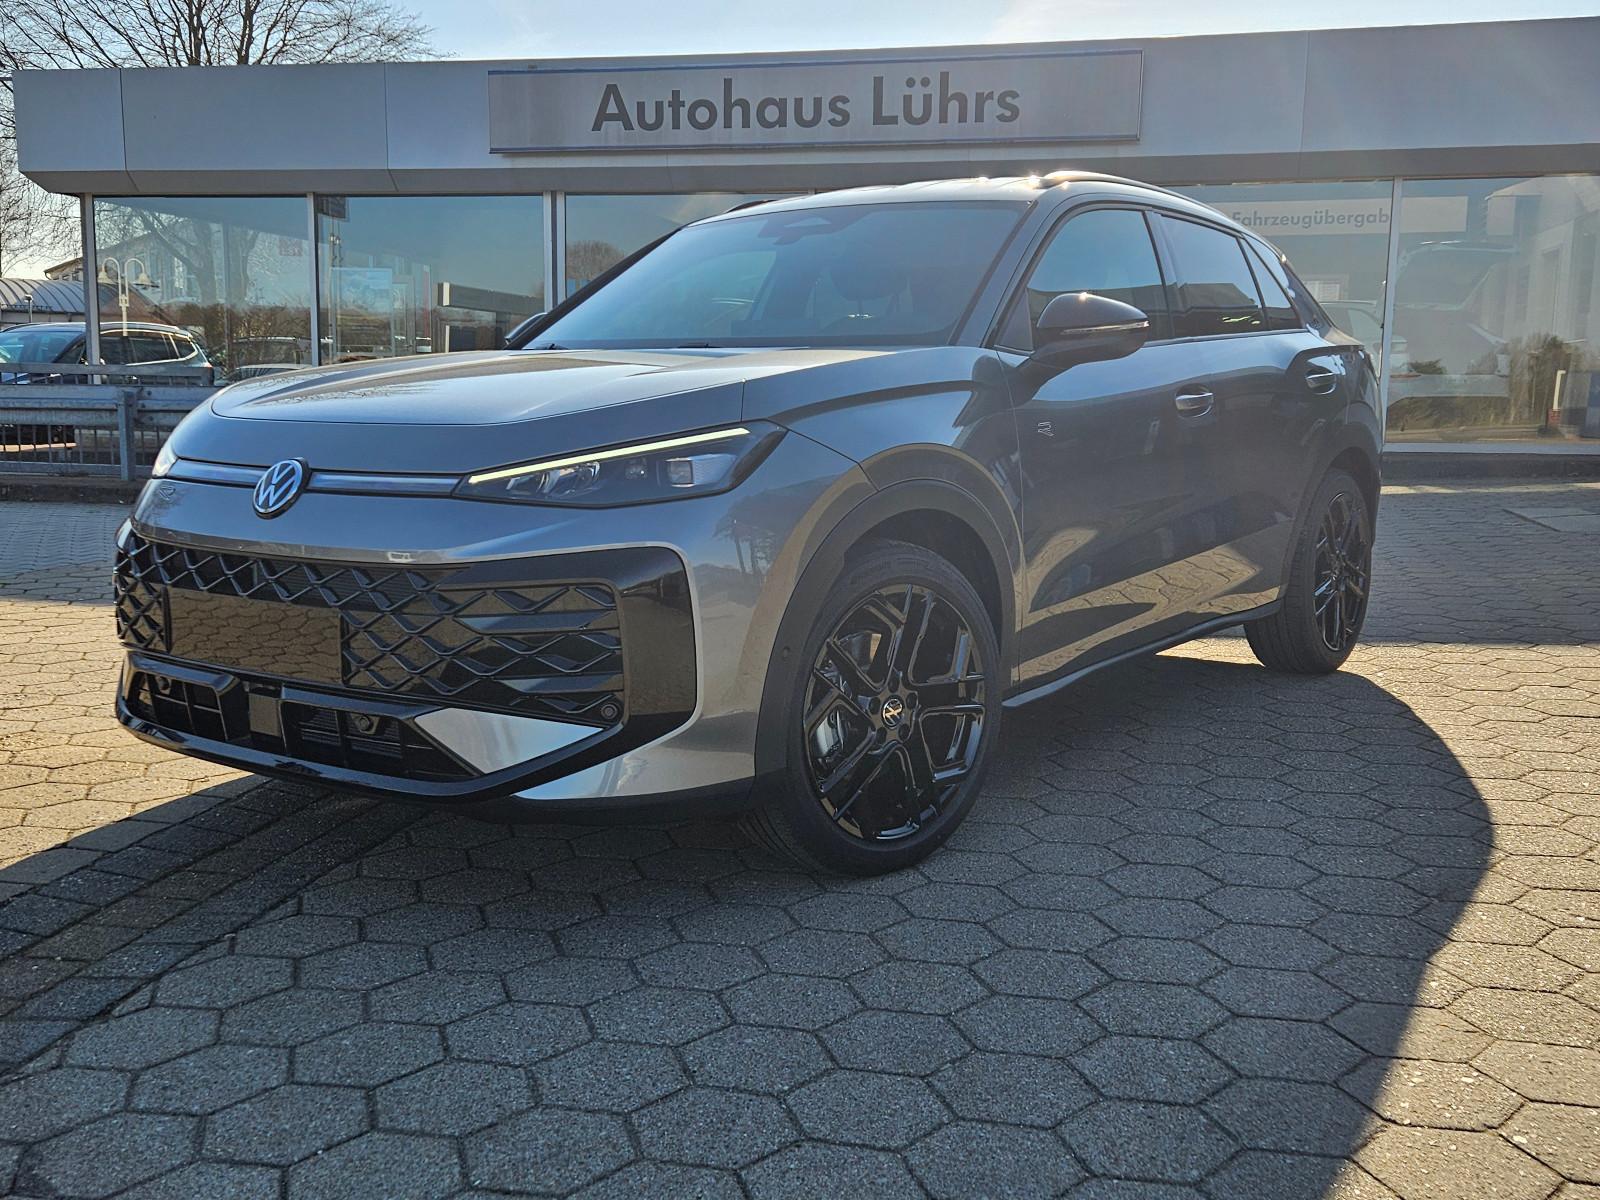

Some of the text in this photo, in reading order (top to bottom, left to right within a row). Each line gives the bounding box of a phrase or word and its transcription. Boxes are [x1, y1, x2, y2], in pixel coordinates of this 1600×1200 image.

[591, 71, 1020, 132] Autohaus Lührs
[1232, 208, 1391, 229] Fahrzeugübergab
